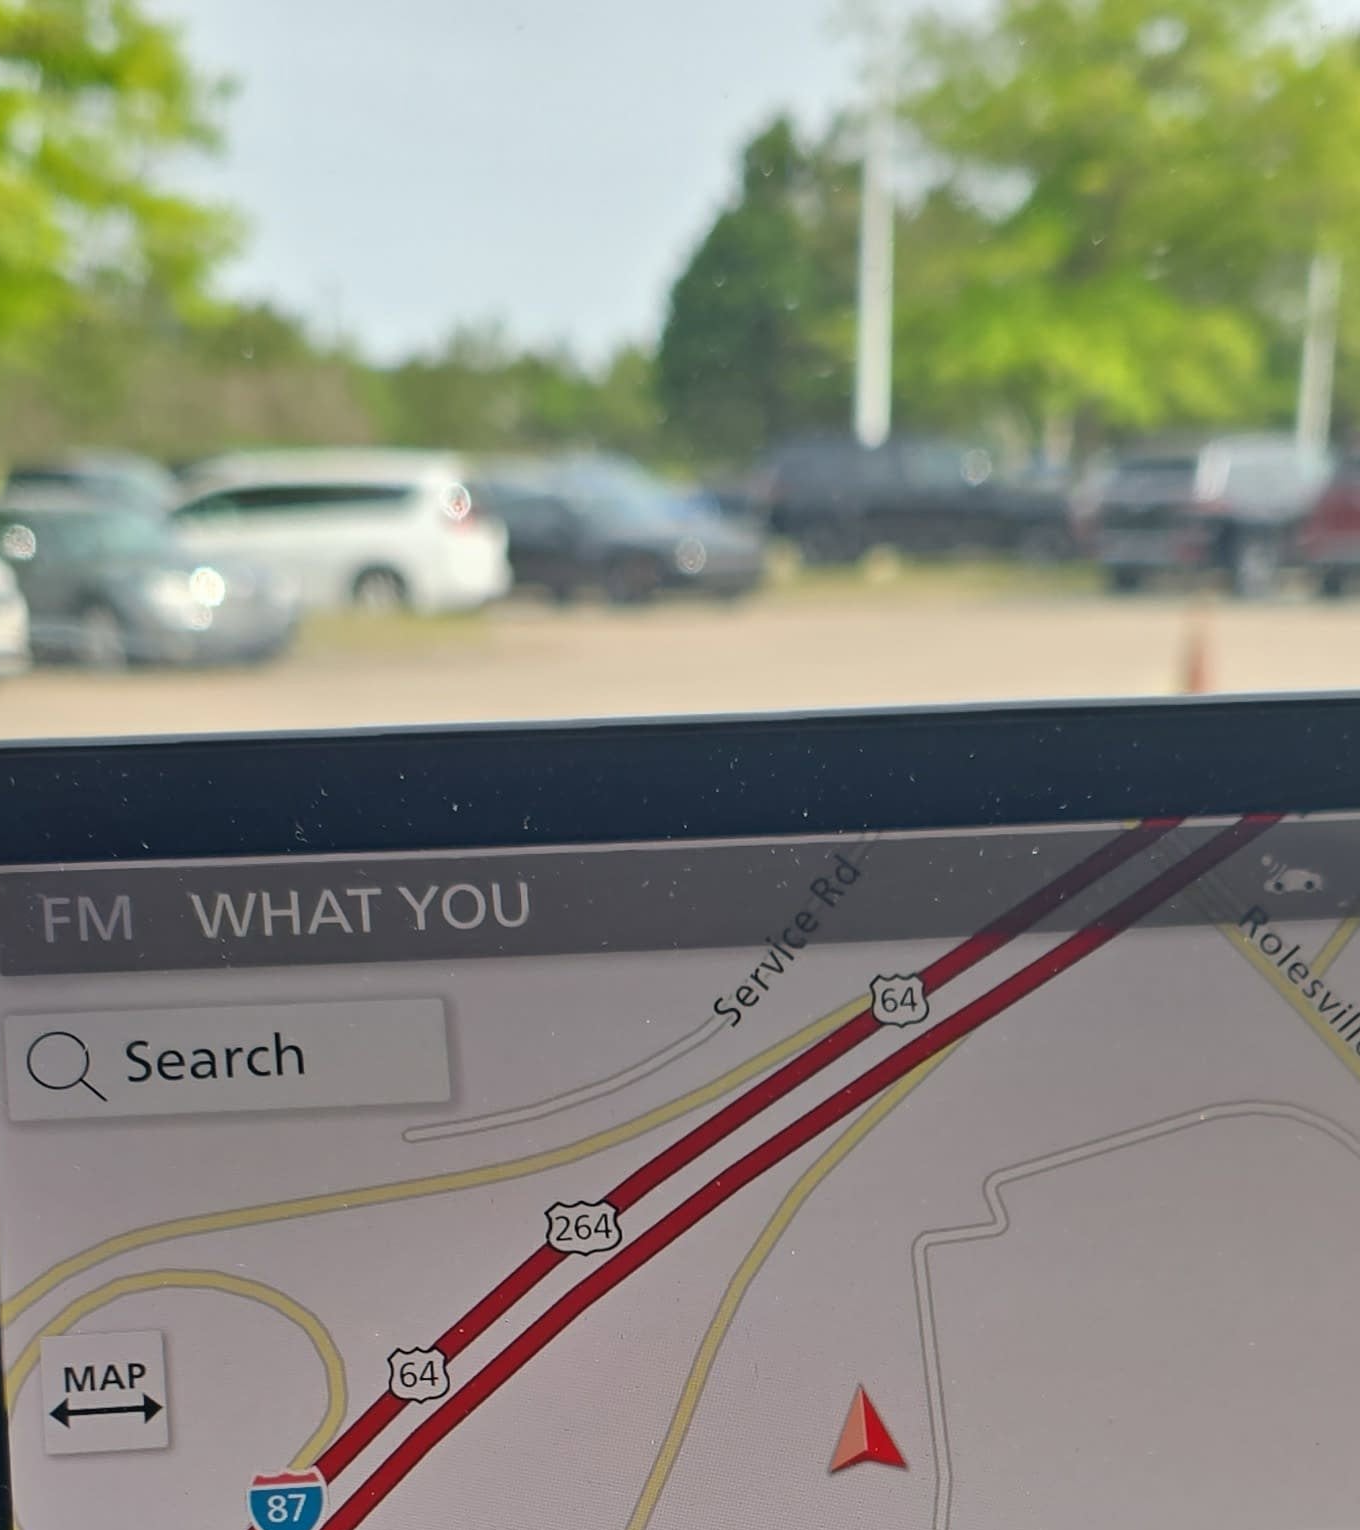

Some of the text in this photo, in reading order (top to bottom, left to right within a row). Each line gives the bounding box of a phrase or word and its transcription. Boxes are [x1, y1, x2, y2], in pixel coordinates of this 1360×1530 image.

[41, 881, 530, 943] FM WHAT YOU
[713, 854, 862, 1028] Service Rd
[880, 986, 918, 1013] 64
[124, 1032, 307, 1086] Search
[554, 1211, 613, 1243] 264
[63, 1364, 147, 1394] MAP
[398, 1359, 439, 1389] 64
[266, 1493, 307, 1525] 87
